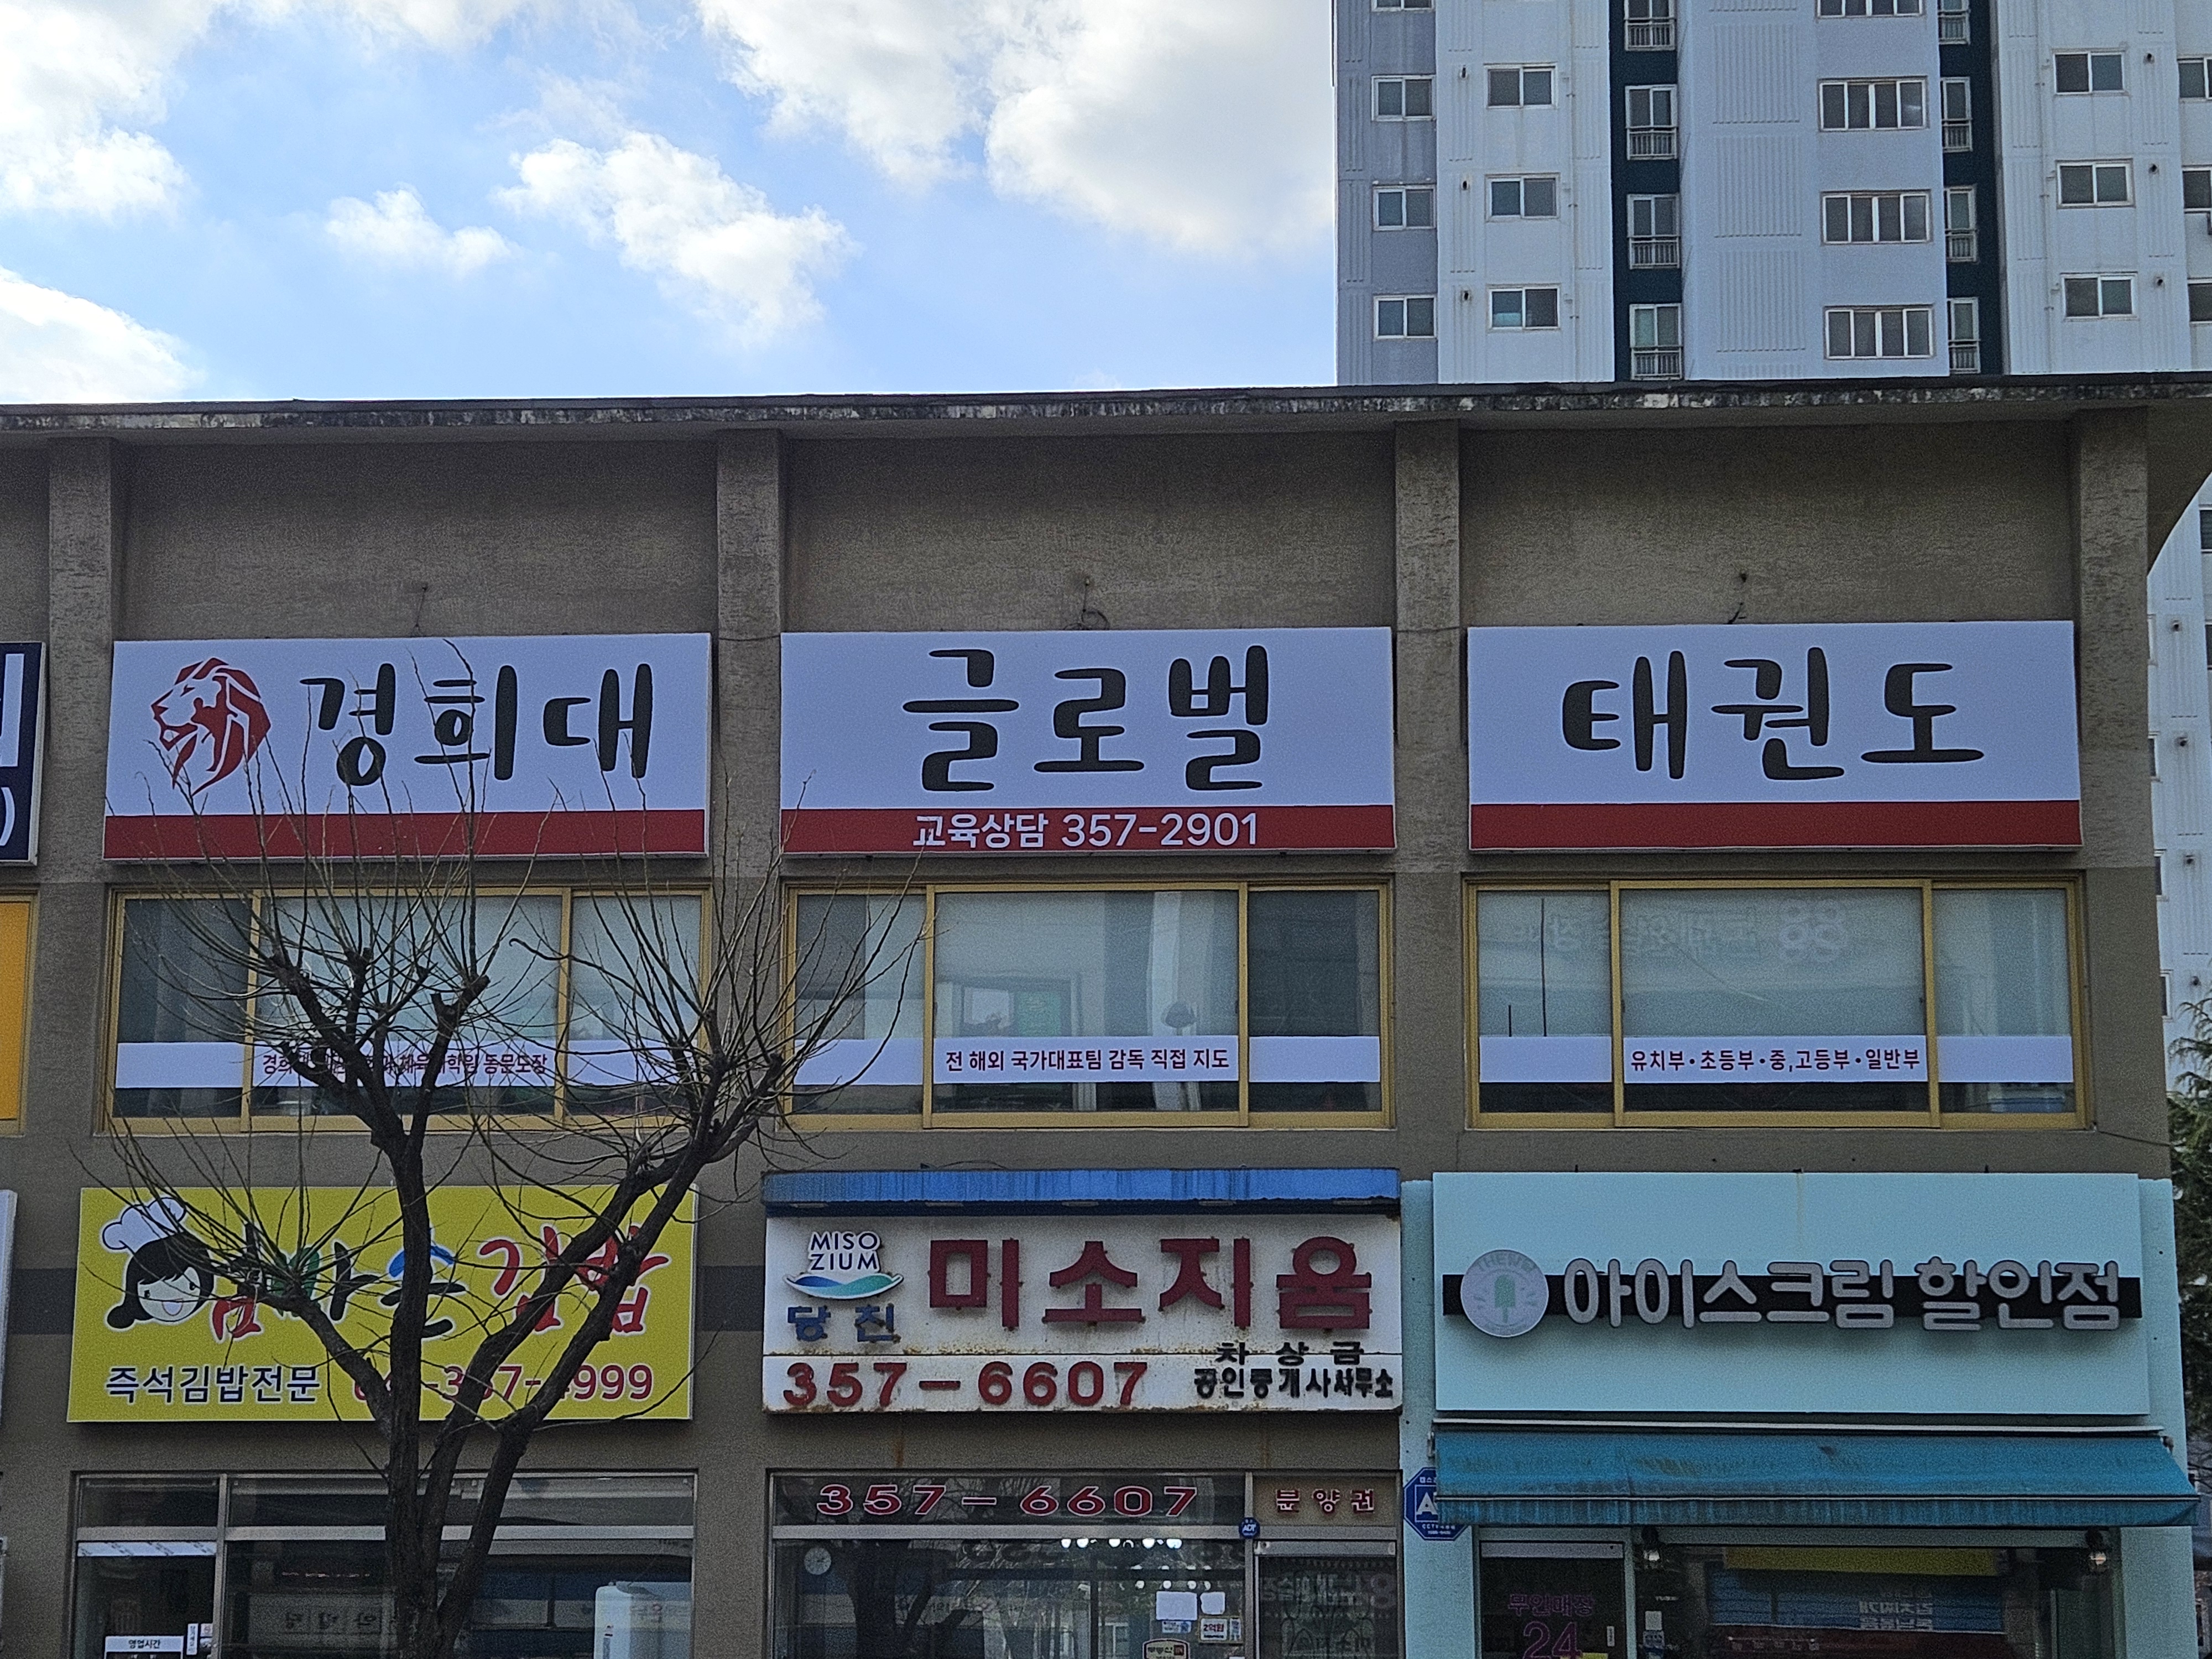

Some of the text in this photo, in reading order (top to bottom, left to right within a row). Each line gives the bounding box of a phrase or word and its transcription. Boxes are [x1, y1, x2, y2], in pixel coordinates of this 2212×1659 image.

[300, 663, 653, 786] 경희대
[902, 645, 1269, 791] 글로벌
[1562, 647, 1984, 780] 태권도
[912, 813, 1258, 849] 교육상담 357-2901
[400, 1053, 479, 1075] 체육학원
[484, 1053, 547, 1074] 동문도장
[946, 1049, 1230, 1071] 전 해외 국가대표팀 감독 직접 지도
[811, 1233, 878, 1250] MISO
[811, 1253, 878, 1270] ZIUM
[930, 1236, 1372, 1330] 미소지움
[1564, 1256, 2121, 1331] 아이스크림 할인점
[787, 1303, 901, 1343] 당진
[106, 1365, 320, 1403] 즉석김밥전문
[782, 1361, 1149, 1408] 357-6607
[816, 1484, 1199, 1517] 357-6607
[1276, 1489, 1374, 1513] 분양권
[1507, 1593, 1595, 1616] 무인매장
[128, 1640, 161, 1649] 영업시간
[1522, 1621, 1583, 1659] 24
